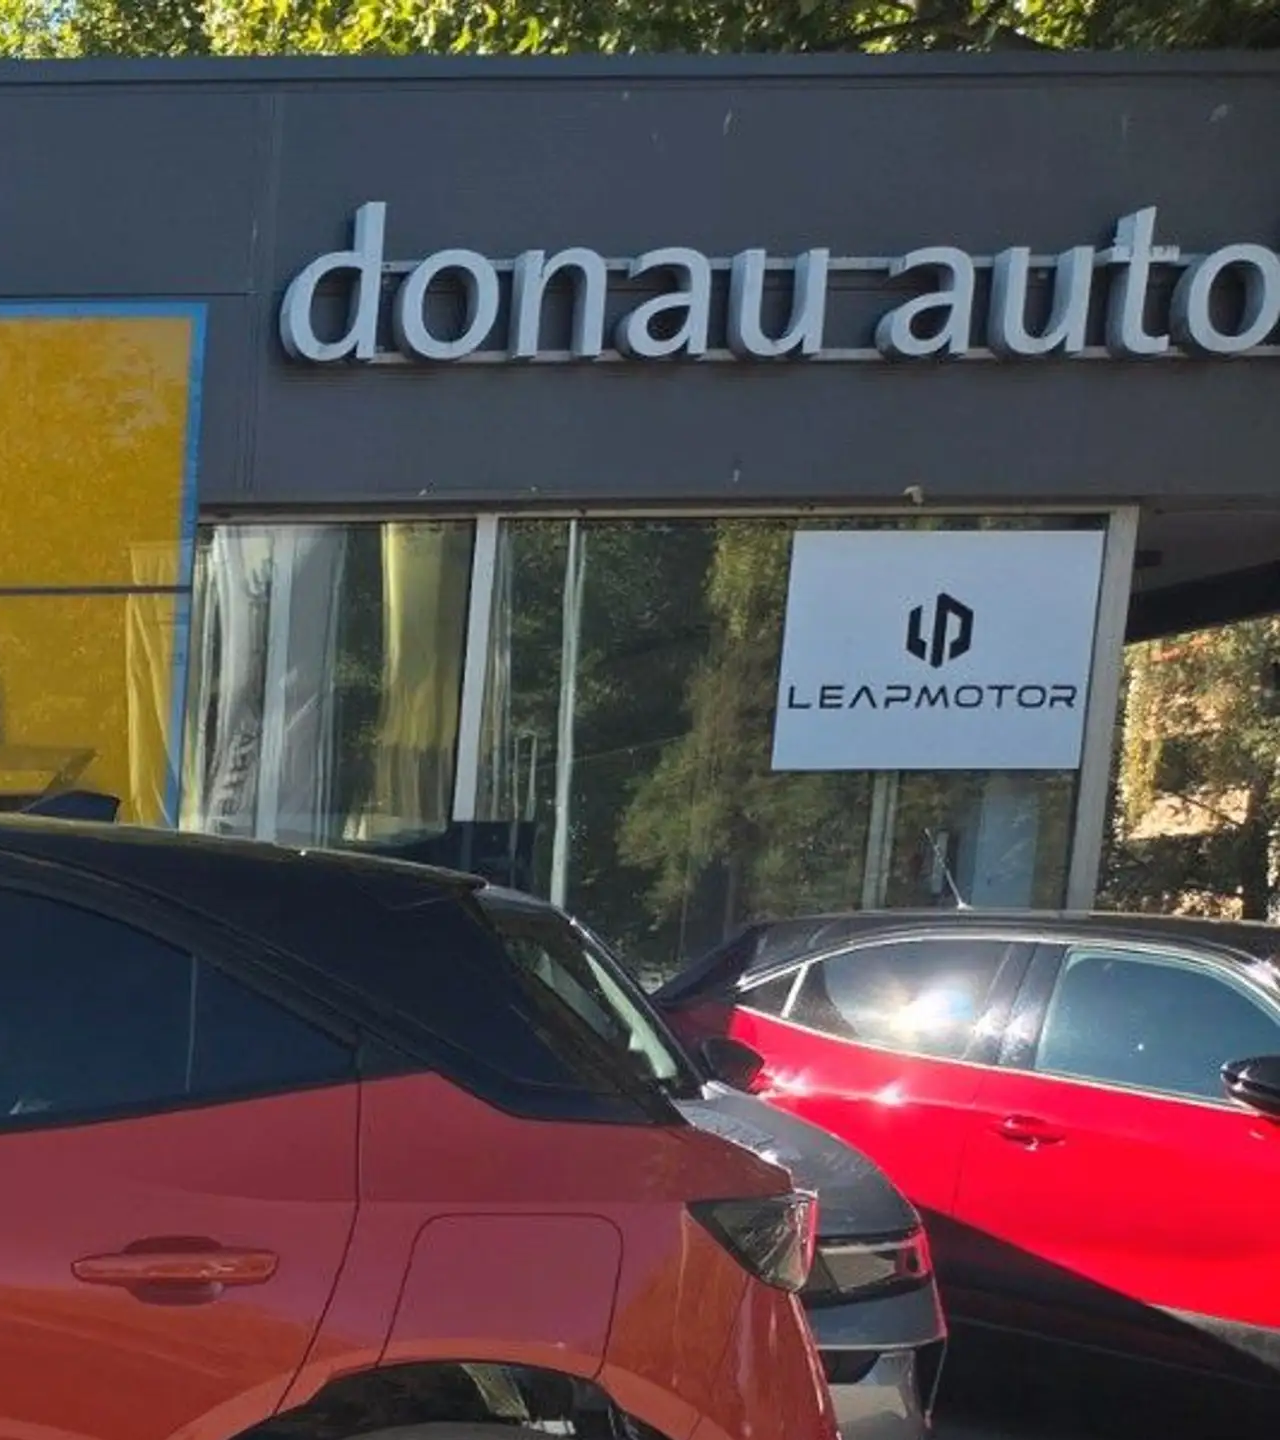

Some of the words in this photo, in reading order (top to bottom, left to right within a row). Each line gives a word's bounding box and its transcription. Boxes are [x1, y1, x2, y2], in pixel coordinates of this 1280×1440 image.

[280, 200, 830, 362] donau
[875, 205, 1280, 358] auto
[787, 684, 1078, 710] LEAPMOTOR
